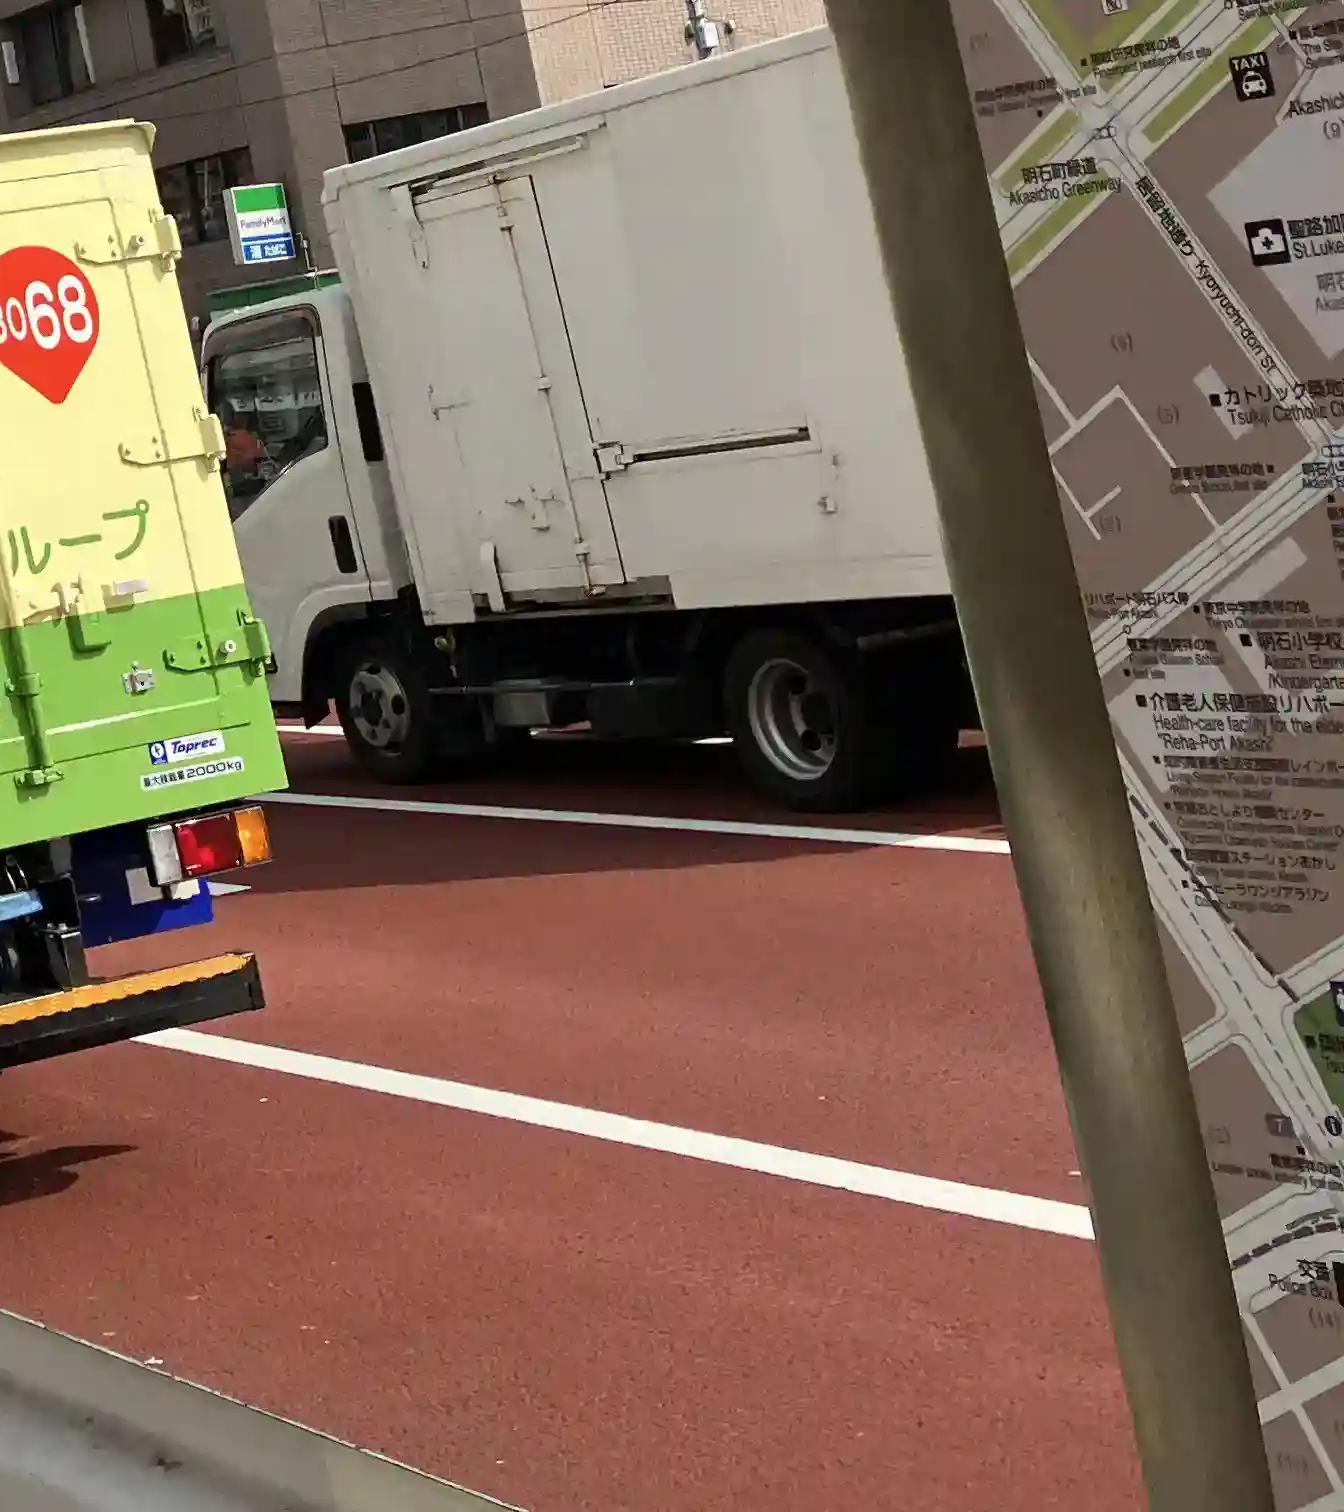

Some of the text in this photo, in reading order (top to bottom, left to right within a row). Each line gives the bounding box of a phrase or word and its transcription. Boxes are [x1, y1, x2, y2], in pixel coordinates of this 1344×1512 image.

[1232, 54, 1267, 72] TAXI
[1062, 175, 1123, 198] Greenway
[1223, 379, 1344, 406] カトリック築地
[1290, 717, 1313, 734] the
[171, 737, 217, 754] Toprec
